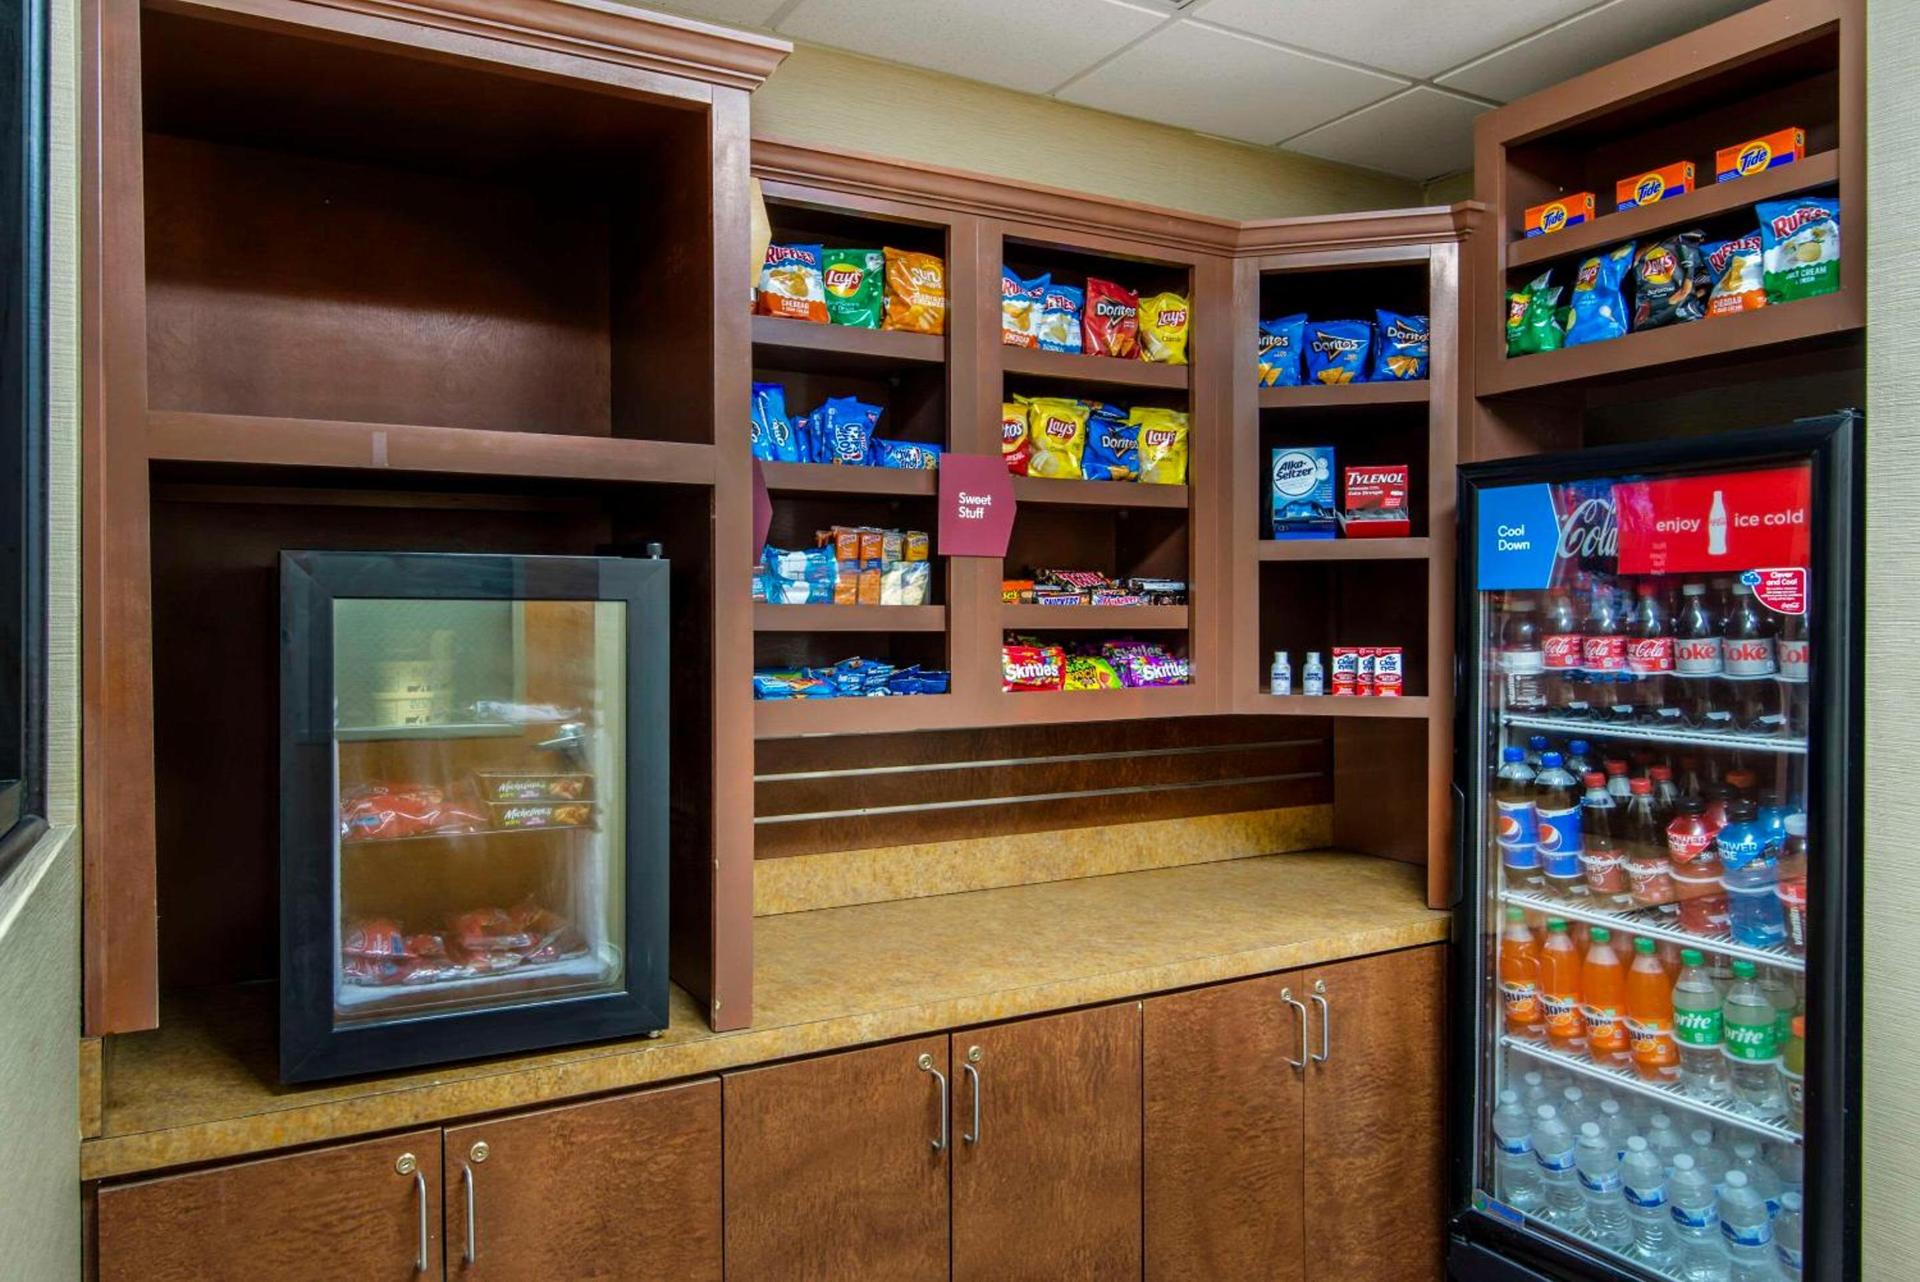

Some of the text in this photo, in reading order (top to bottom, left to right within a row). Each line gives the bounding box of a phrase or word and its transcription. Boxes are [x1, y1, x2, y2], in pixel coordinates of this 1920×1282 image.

[1740, 149, 1768, 172] Tide
[1637, 181, 1662, 202] Tide
[1543, 210, 1566, 227] Tide
[1708, 236, 1762, 272] RUFFLES
[1096, 303, 1137, 318] Doritos
[1313, 340, 1358, 352] Doritos
[1279, 460, 1308, 471] Alka-
[1276, 467, 1315, 481] Seltzer
[1347, 472, 1405, 485] TYLENOL
[959, 492, 992, 506] Sweet
[959, 506, 985, 519] Stuff
[1656, 518, 1701, 534] enjoy
[1734, 513, 1760, 528] ice
[1764, 508, 1804, 526] cold
[1498, 524, 1525, 537] Cool
[1498, 539, 1530, 551] Down
[1005, 662, 1060, 681] Skittles
[1142, 661, 1188, 681] Skittle
